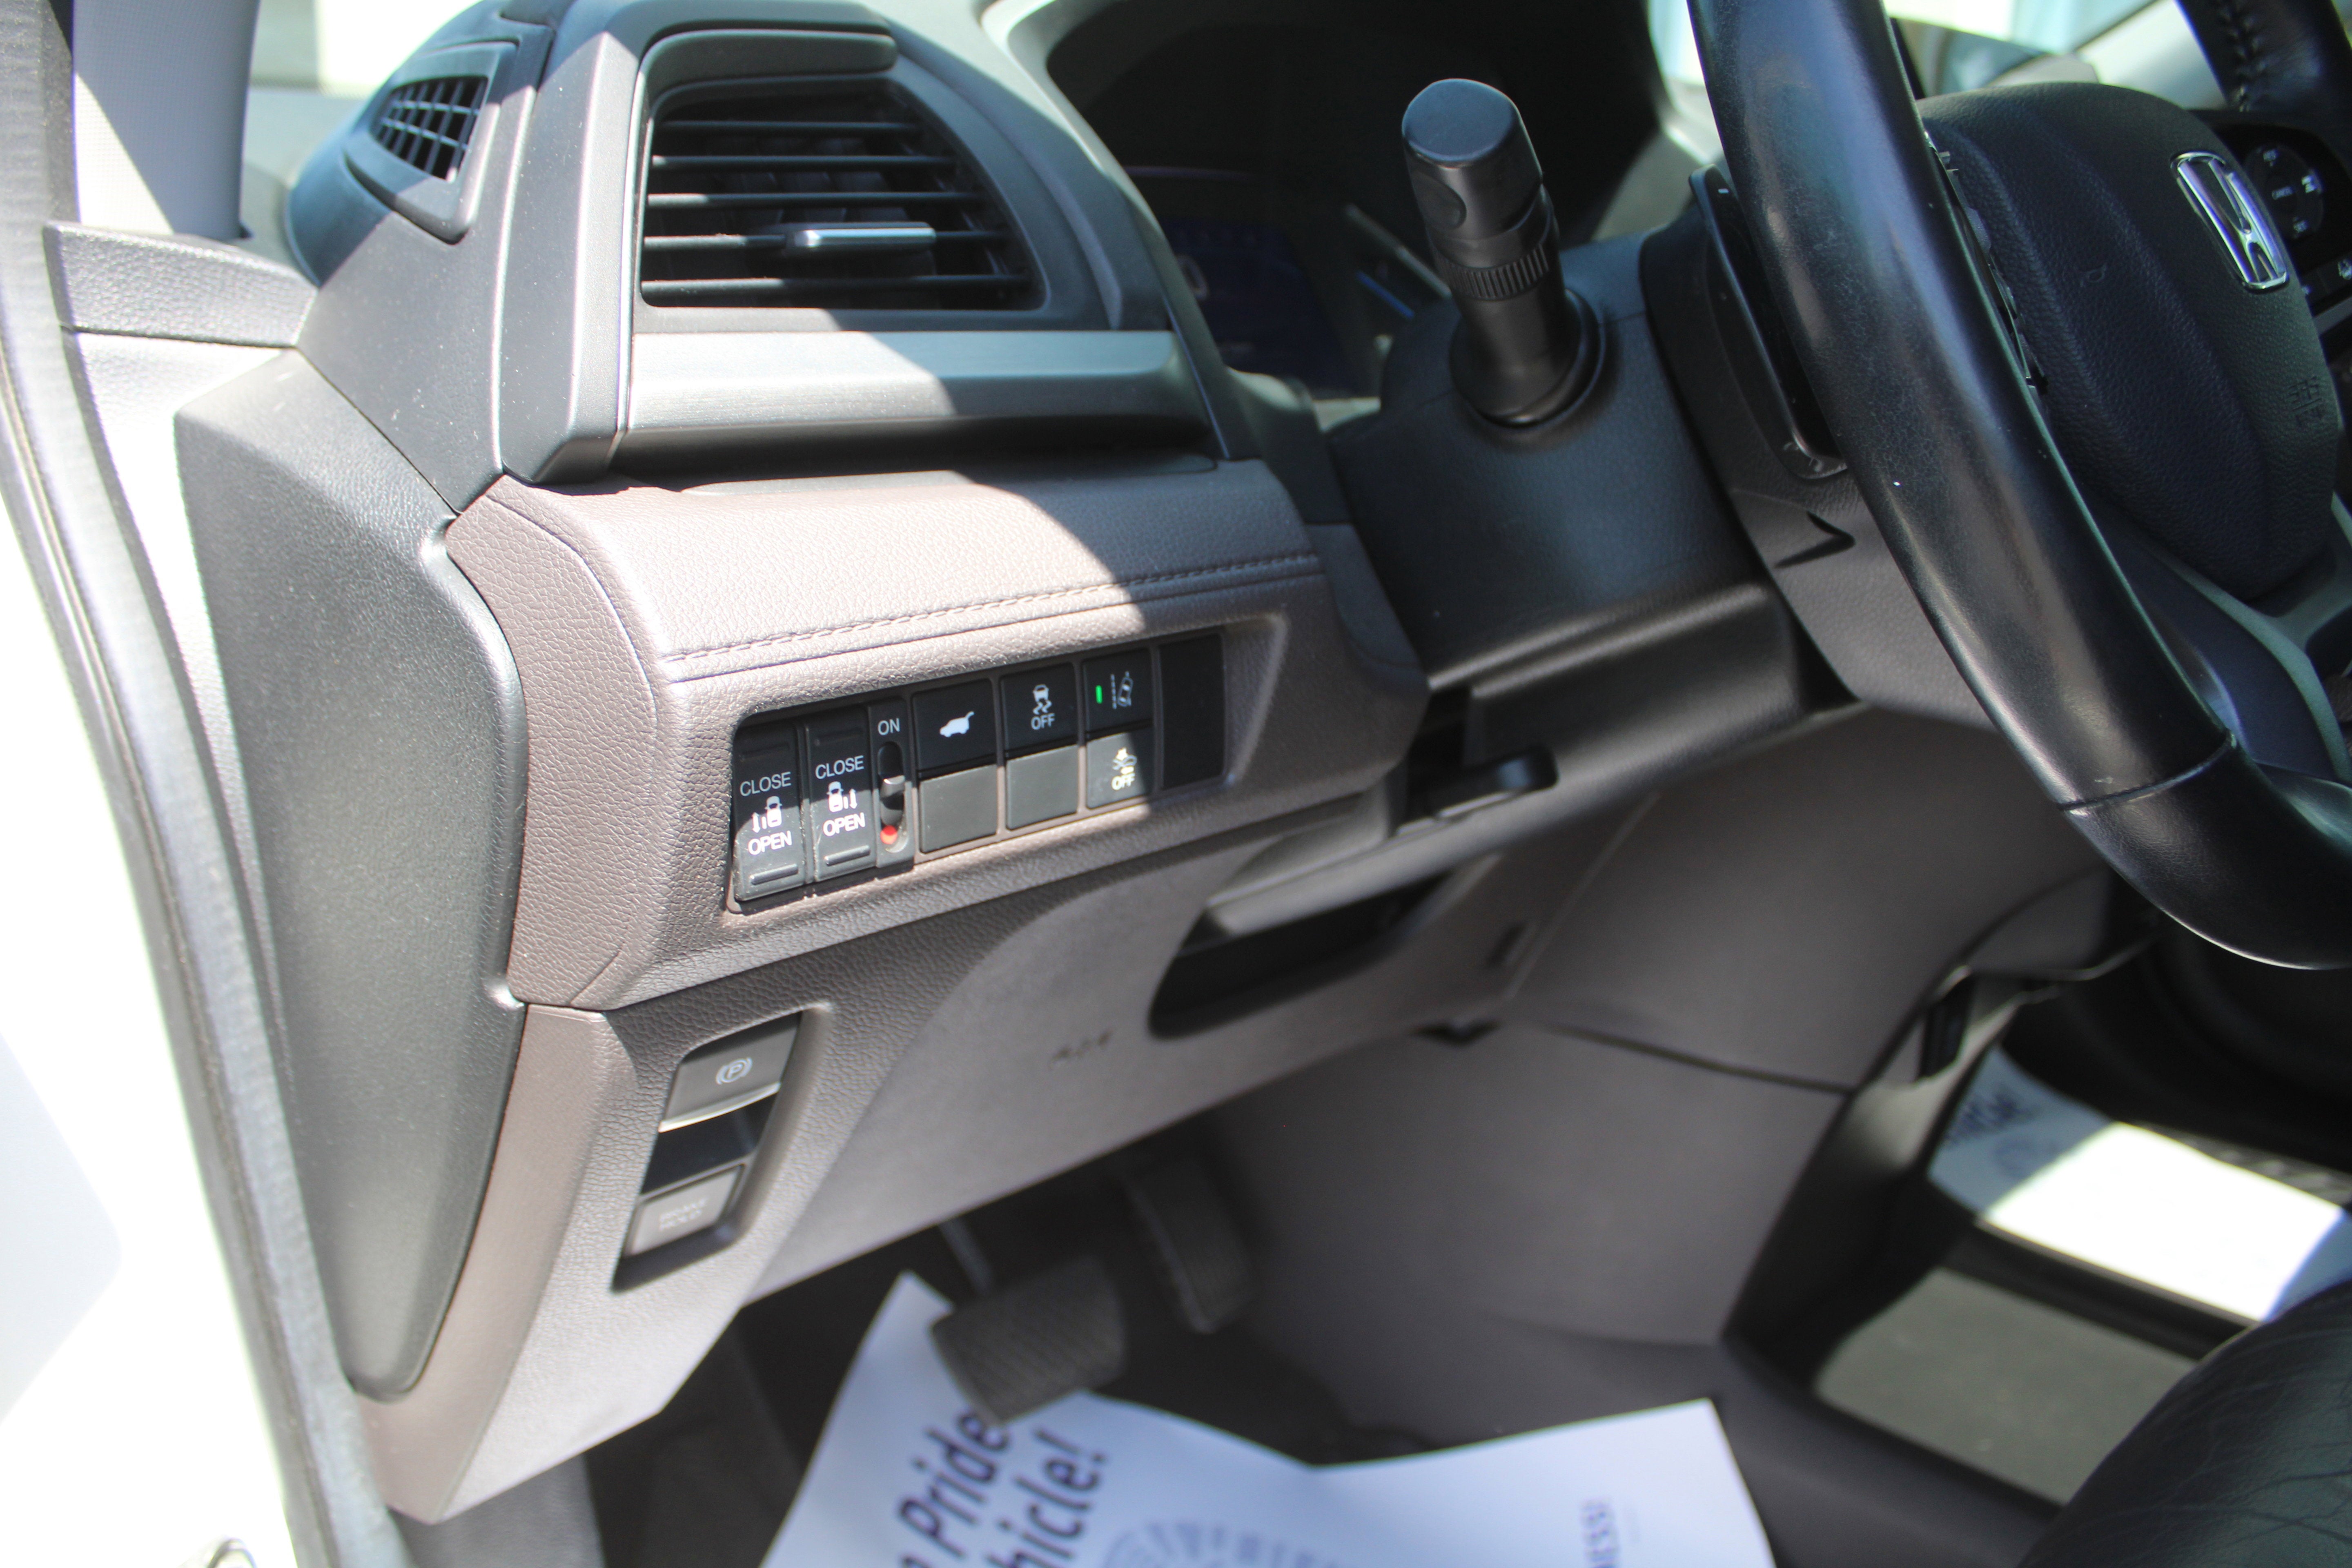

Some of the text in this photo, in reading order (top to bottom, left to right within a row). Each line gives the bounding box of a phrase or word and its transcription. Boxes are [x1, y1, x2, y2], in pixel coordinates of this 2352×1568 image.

[878, 717, 900, 735] ON
[1031, 713, 1055, 731] OFF
[815, 755, 864, 780] CLOSE
[739, 771, 792, 797] CLOSE
[1111, 773, 1136, 791] OFF
[822, 812, 866, 837] OPEN
[748, 831, 792, 855] OPEN
[899, 1408, 1009, 1557] Pride
